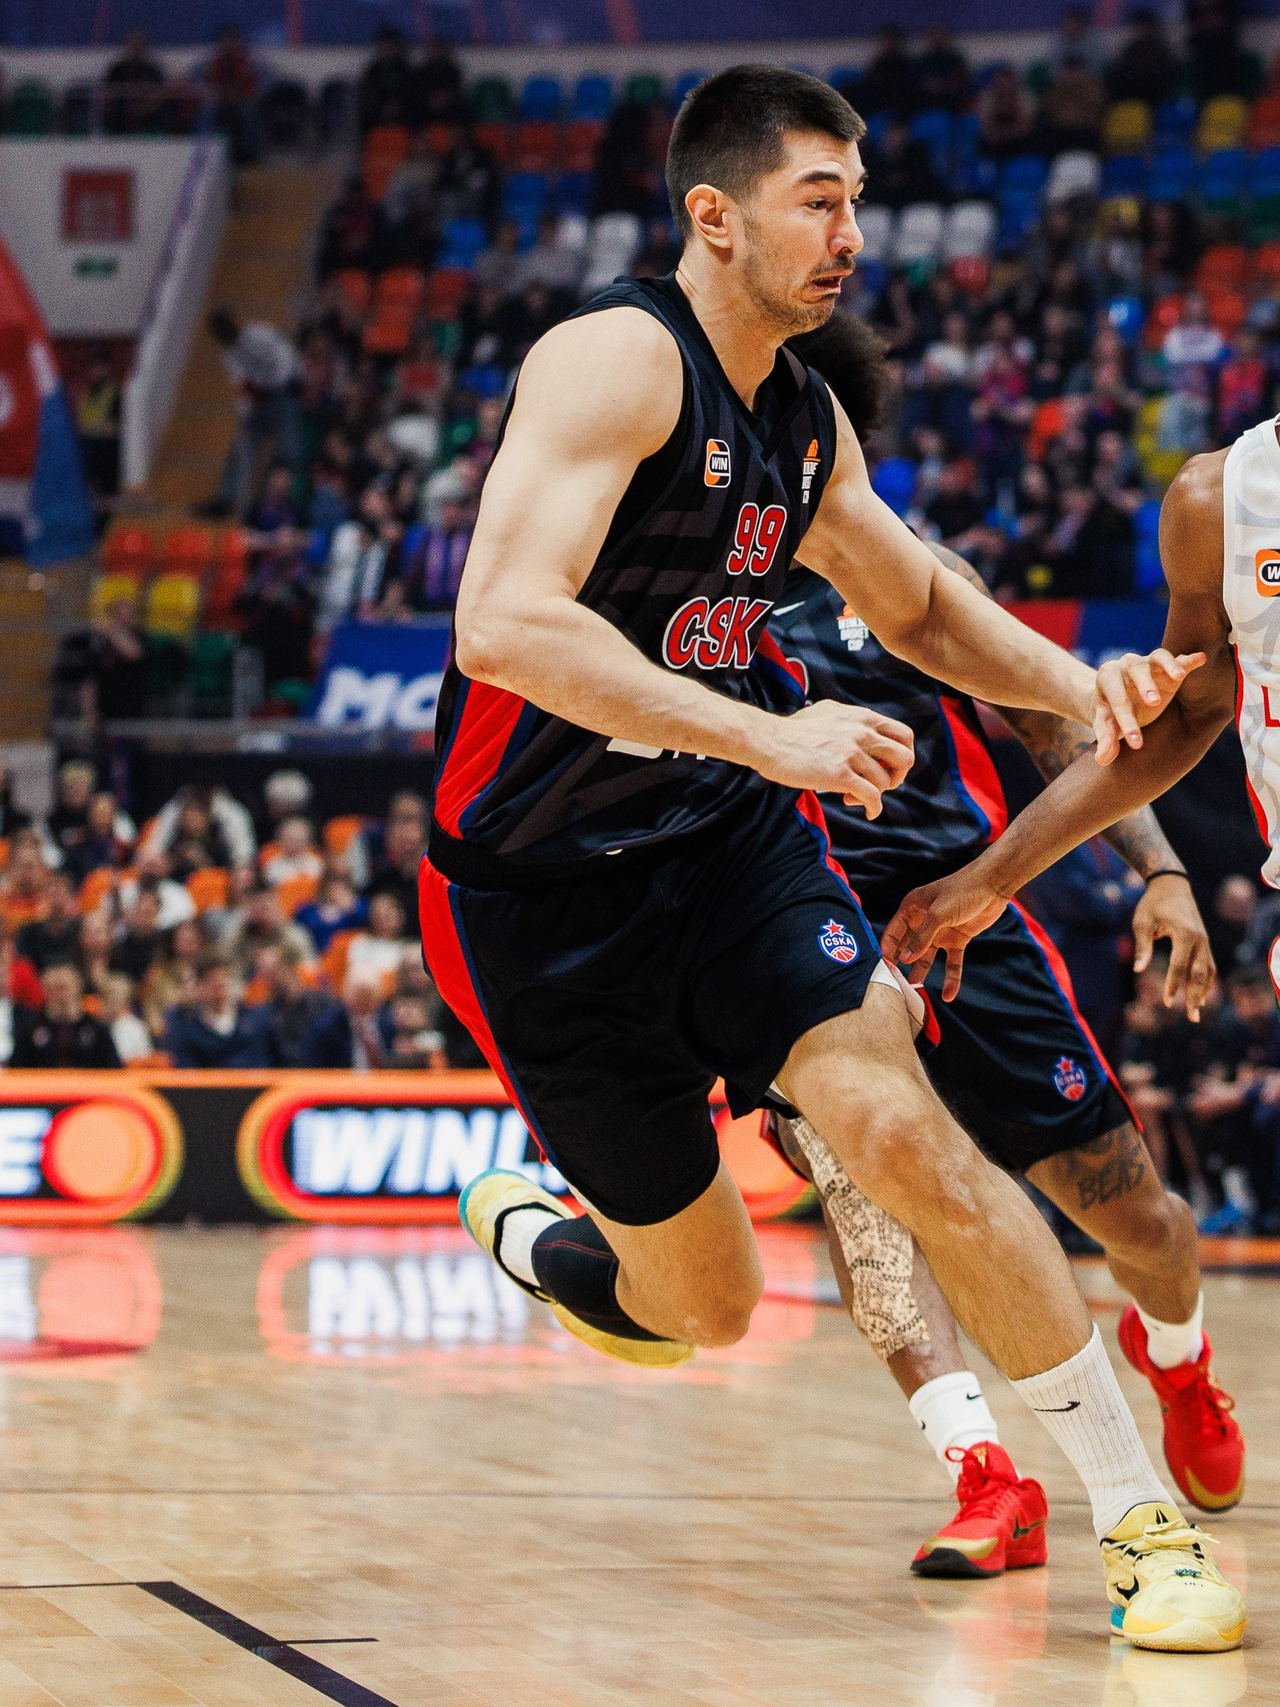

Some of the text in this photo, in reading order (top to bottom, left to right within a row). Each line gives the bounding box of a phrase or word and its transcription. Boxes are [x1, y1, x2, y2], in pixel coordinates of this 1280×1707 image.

[711, 456, 728, 471] WIN
[726, 502, 787, 576] 99
[662, 596, 774, 670] CSK
[824, 937, 853, 947] CSKA
[299, 1106, 568, 1195] WINL
